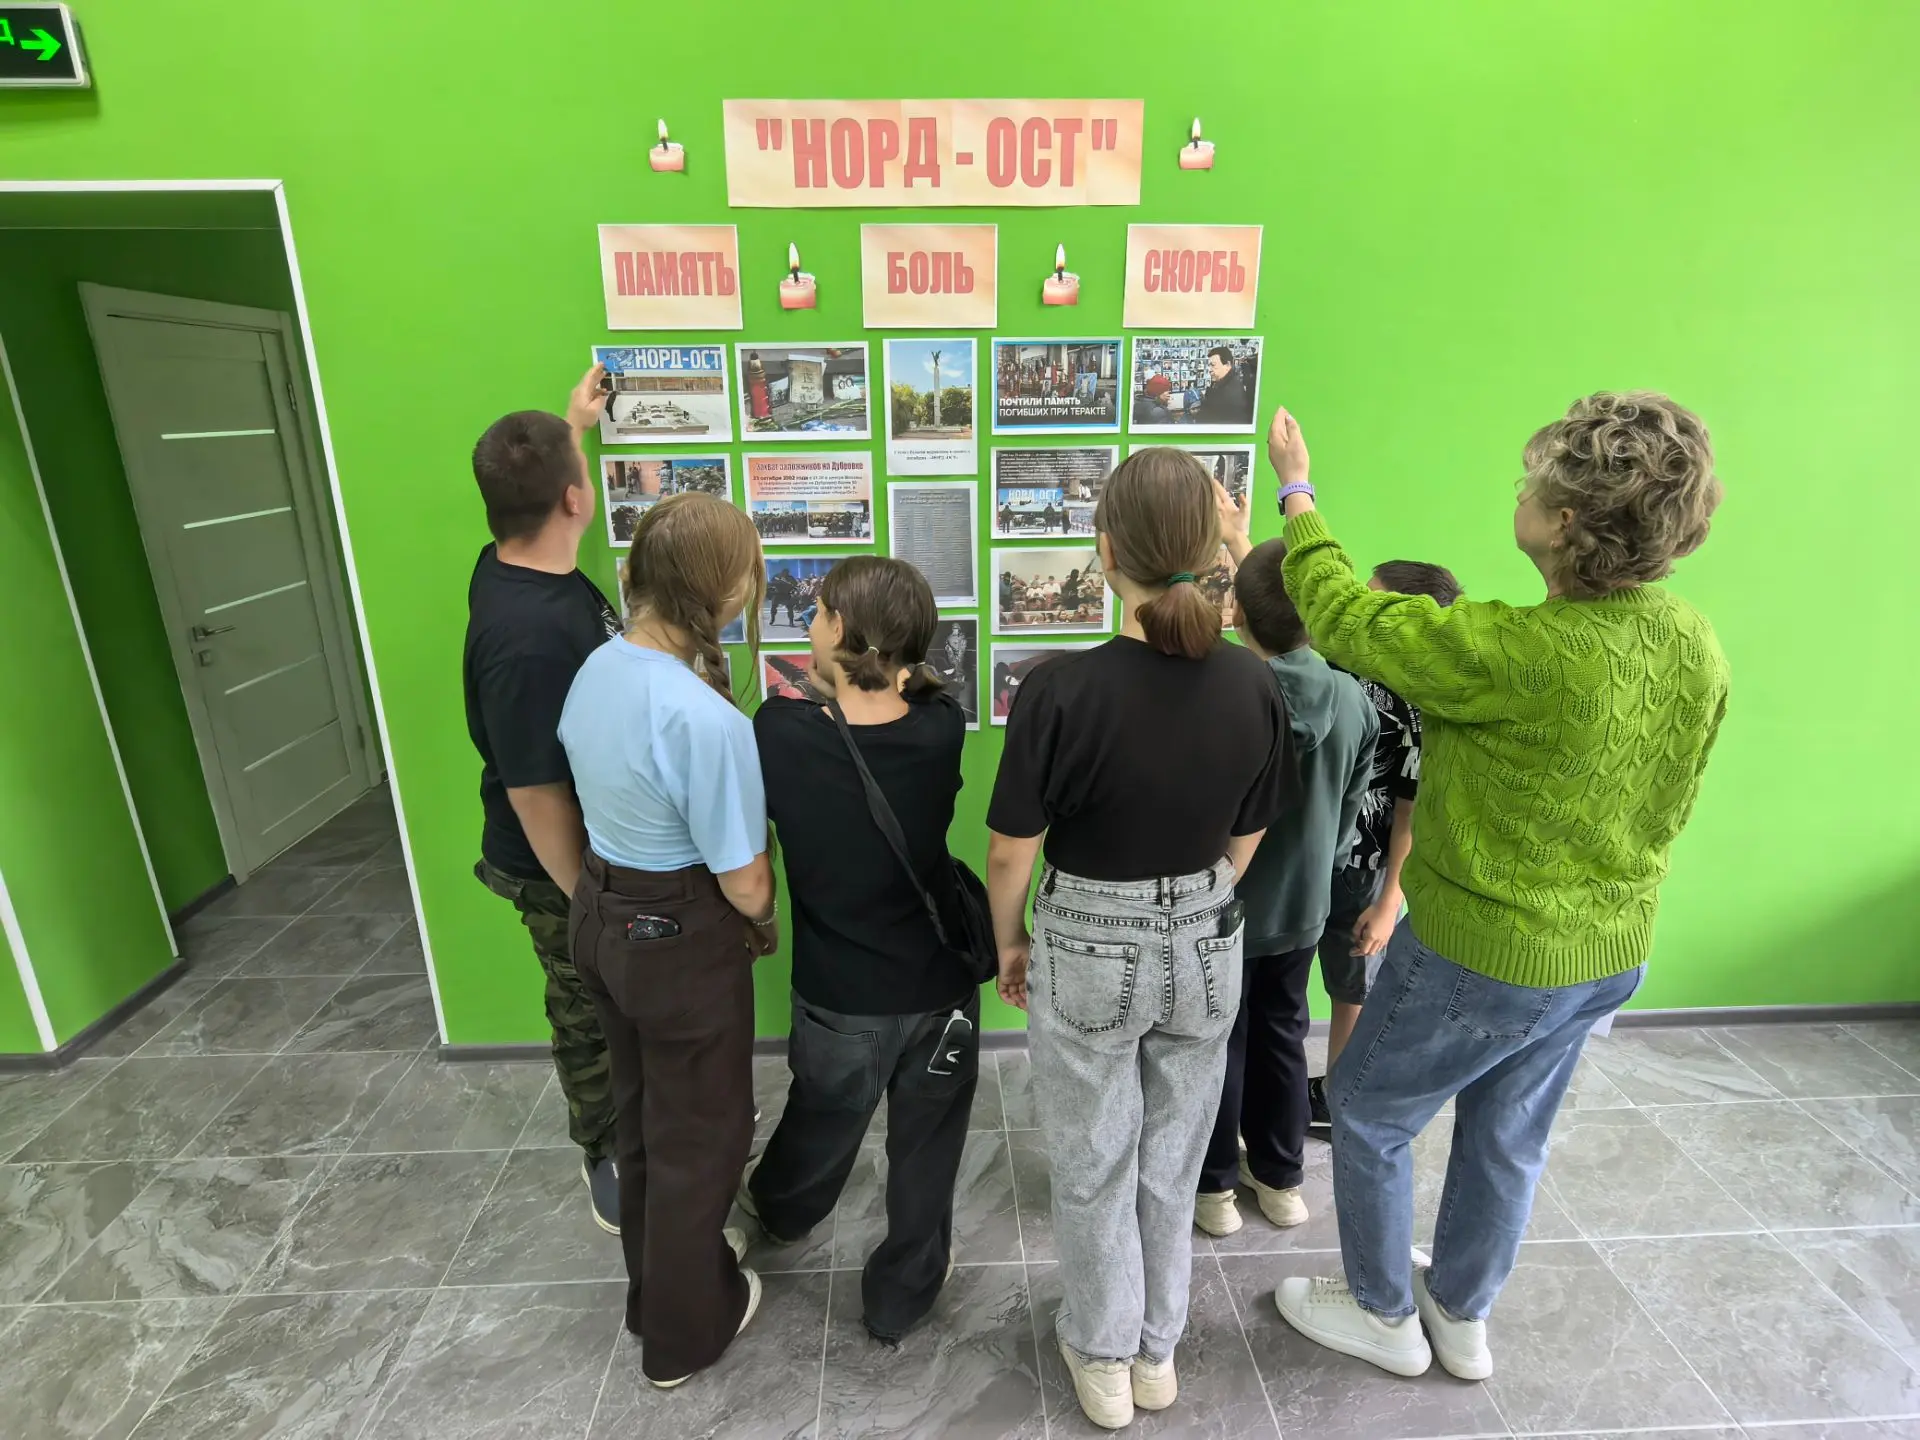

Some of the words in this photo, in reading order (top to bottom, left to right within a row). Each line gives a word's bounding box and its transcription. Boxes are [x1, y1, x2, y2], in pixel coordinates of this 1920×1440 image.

[614, 251, 735, 297] ПАМЯТЬ
[887, 251, 975, 295] БОЛЬ
[1142, 248, 1247, 293] СКОРБЬ
[634, 348, 721, 370] НОРД-ОСТ
[999, 397, 1042, 406] ПОЧТИЛИ
[1044, 396, 1081, 405] ПАМЯТЬ
[999, 407, 1049, 416] ПОГИБШИХ
[1050, 407, 1069, 416] ПРИ
[1070, 406, 1106, 415] ТЕРАКТЕ
